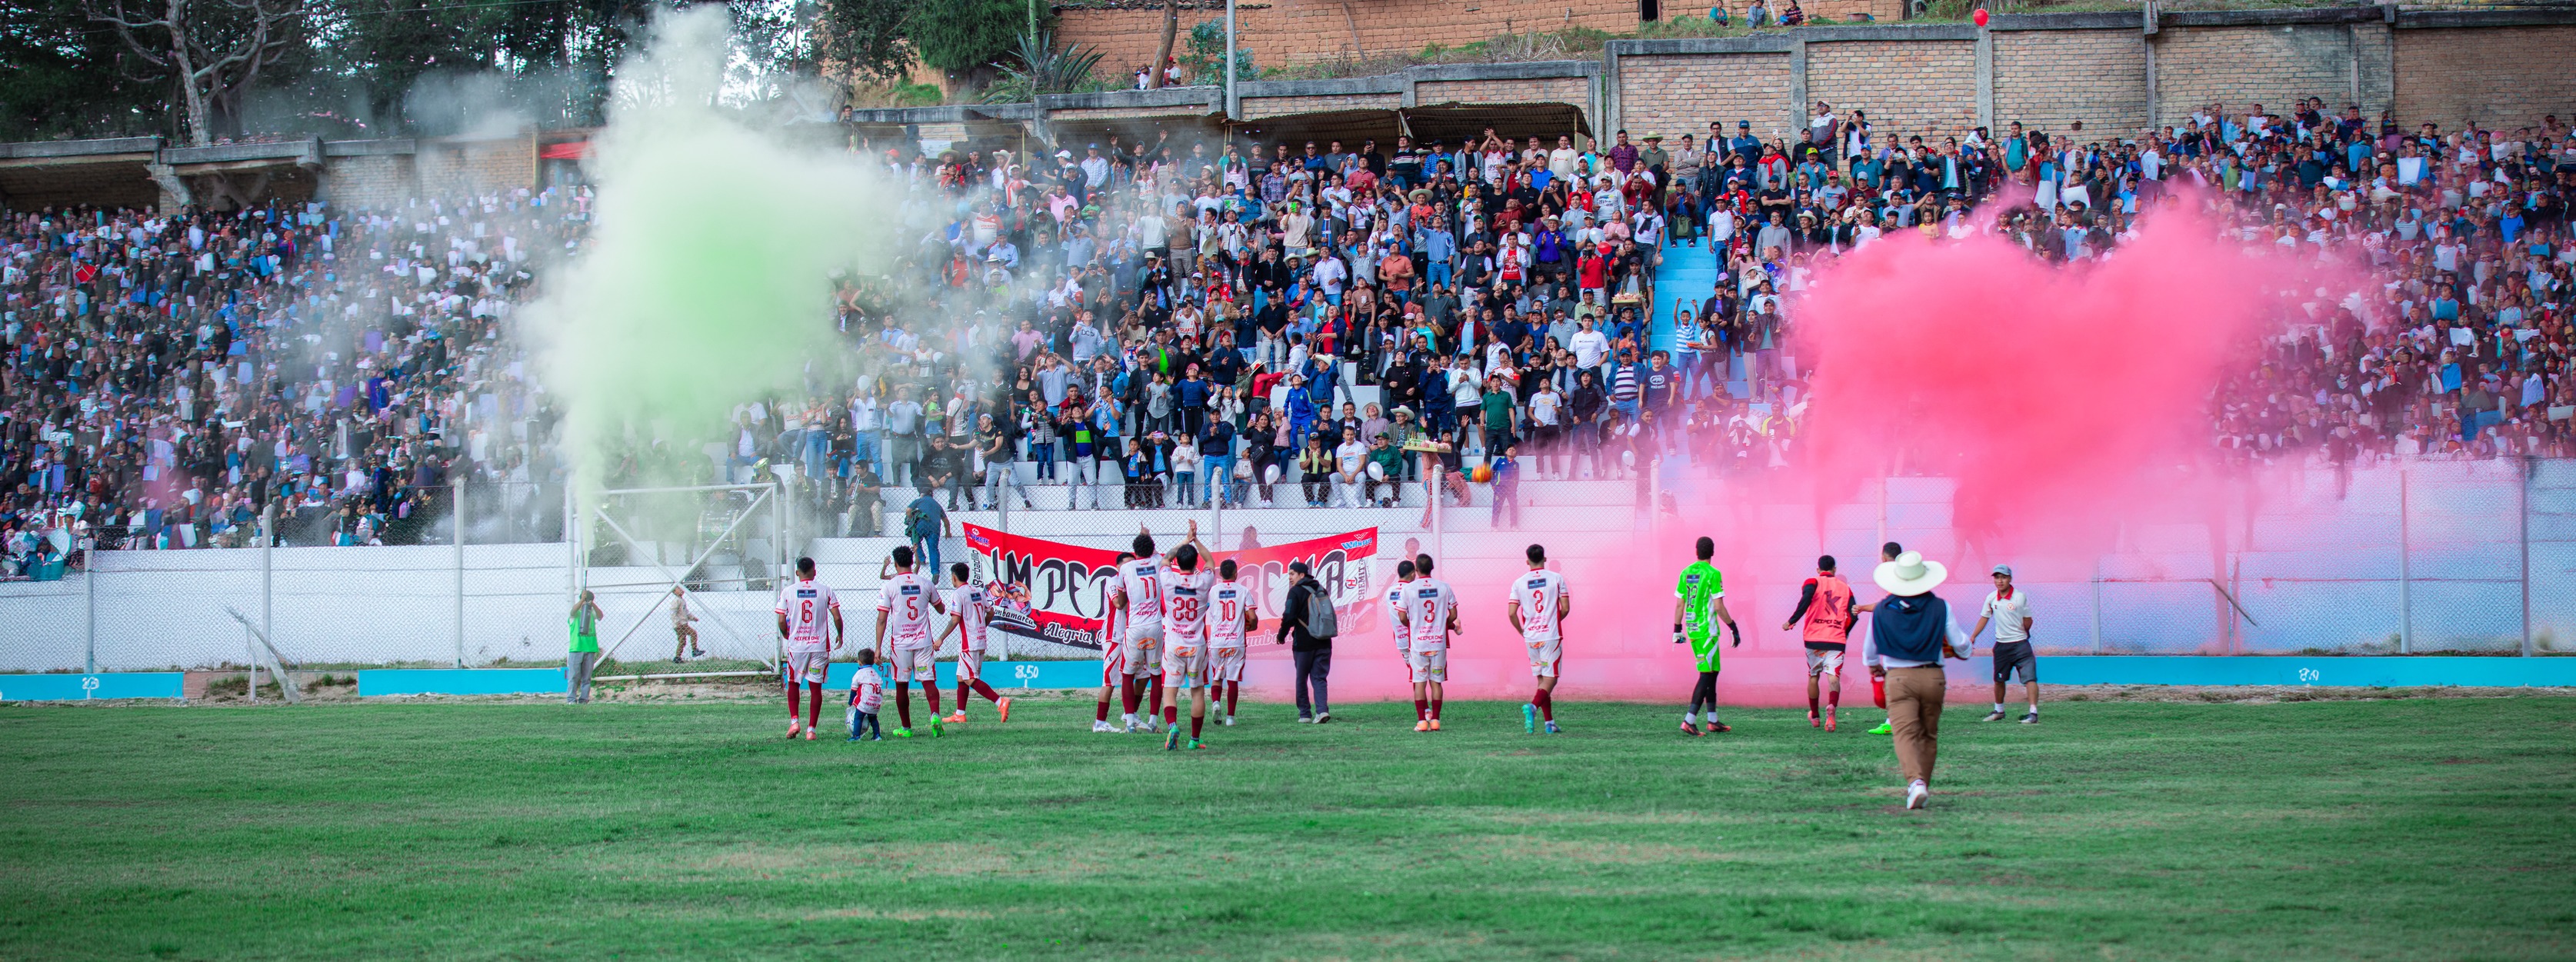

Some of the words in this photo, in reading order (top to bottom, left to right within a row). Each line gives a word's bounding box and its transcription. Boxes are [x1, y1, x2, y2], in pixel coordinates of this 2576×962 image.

[1341, 538, 1373, 549] Wilson
[971, 550, 983, 588] Barbadillo
[1140, 577, 1157, 599] 11
[801, 600, 812, 623] 6
[907, 597, 918, 621] 5
[1173, 597, 1198, 621] 28
[1219, 600, 1235, 621] 10
[1424, 600, 1435, 623] 3
[1533, 590, 1544, 613] 2
[973, 603, 984, 624] 17
[1015, 664, 1038, 679] 8.50
[869, 683, 881, 694] 10
